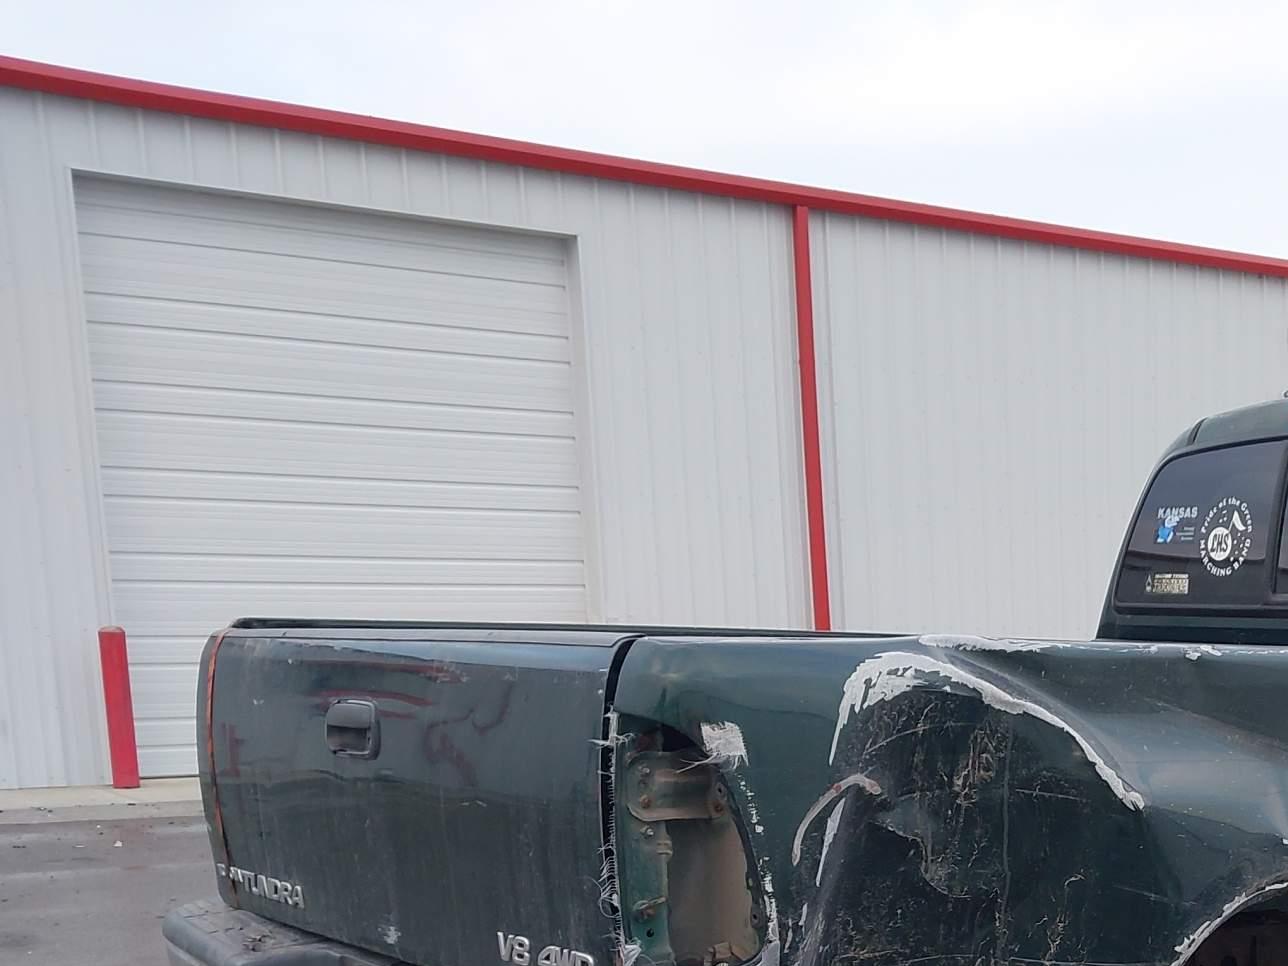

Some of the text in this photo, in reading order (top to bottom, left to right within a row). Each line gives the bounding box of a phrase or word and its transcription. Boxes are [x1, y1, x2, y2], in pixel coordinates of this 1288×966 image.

[1157, 506, 1198, 519] KANSAS
[1200, 496, 1253, 534] Pride of the Green
[1200, 538, 1251, 577] MARCHING BAND
[241, 869, 305, 909] TUNDRA
[496, 930, 531, 966] V8
